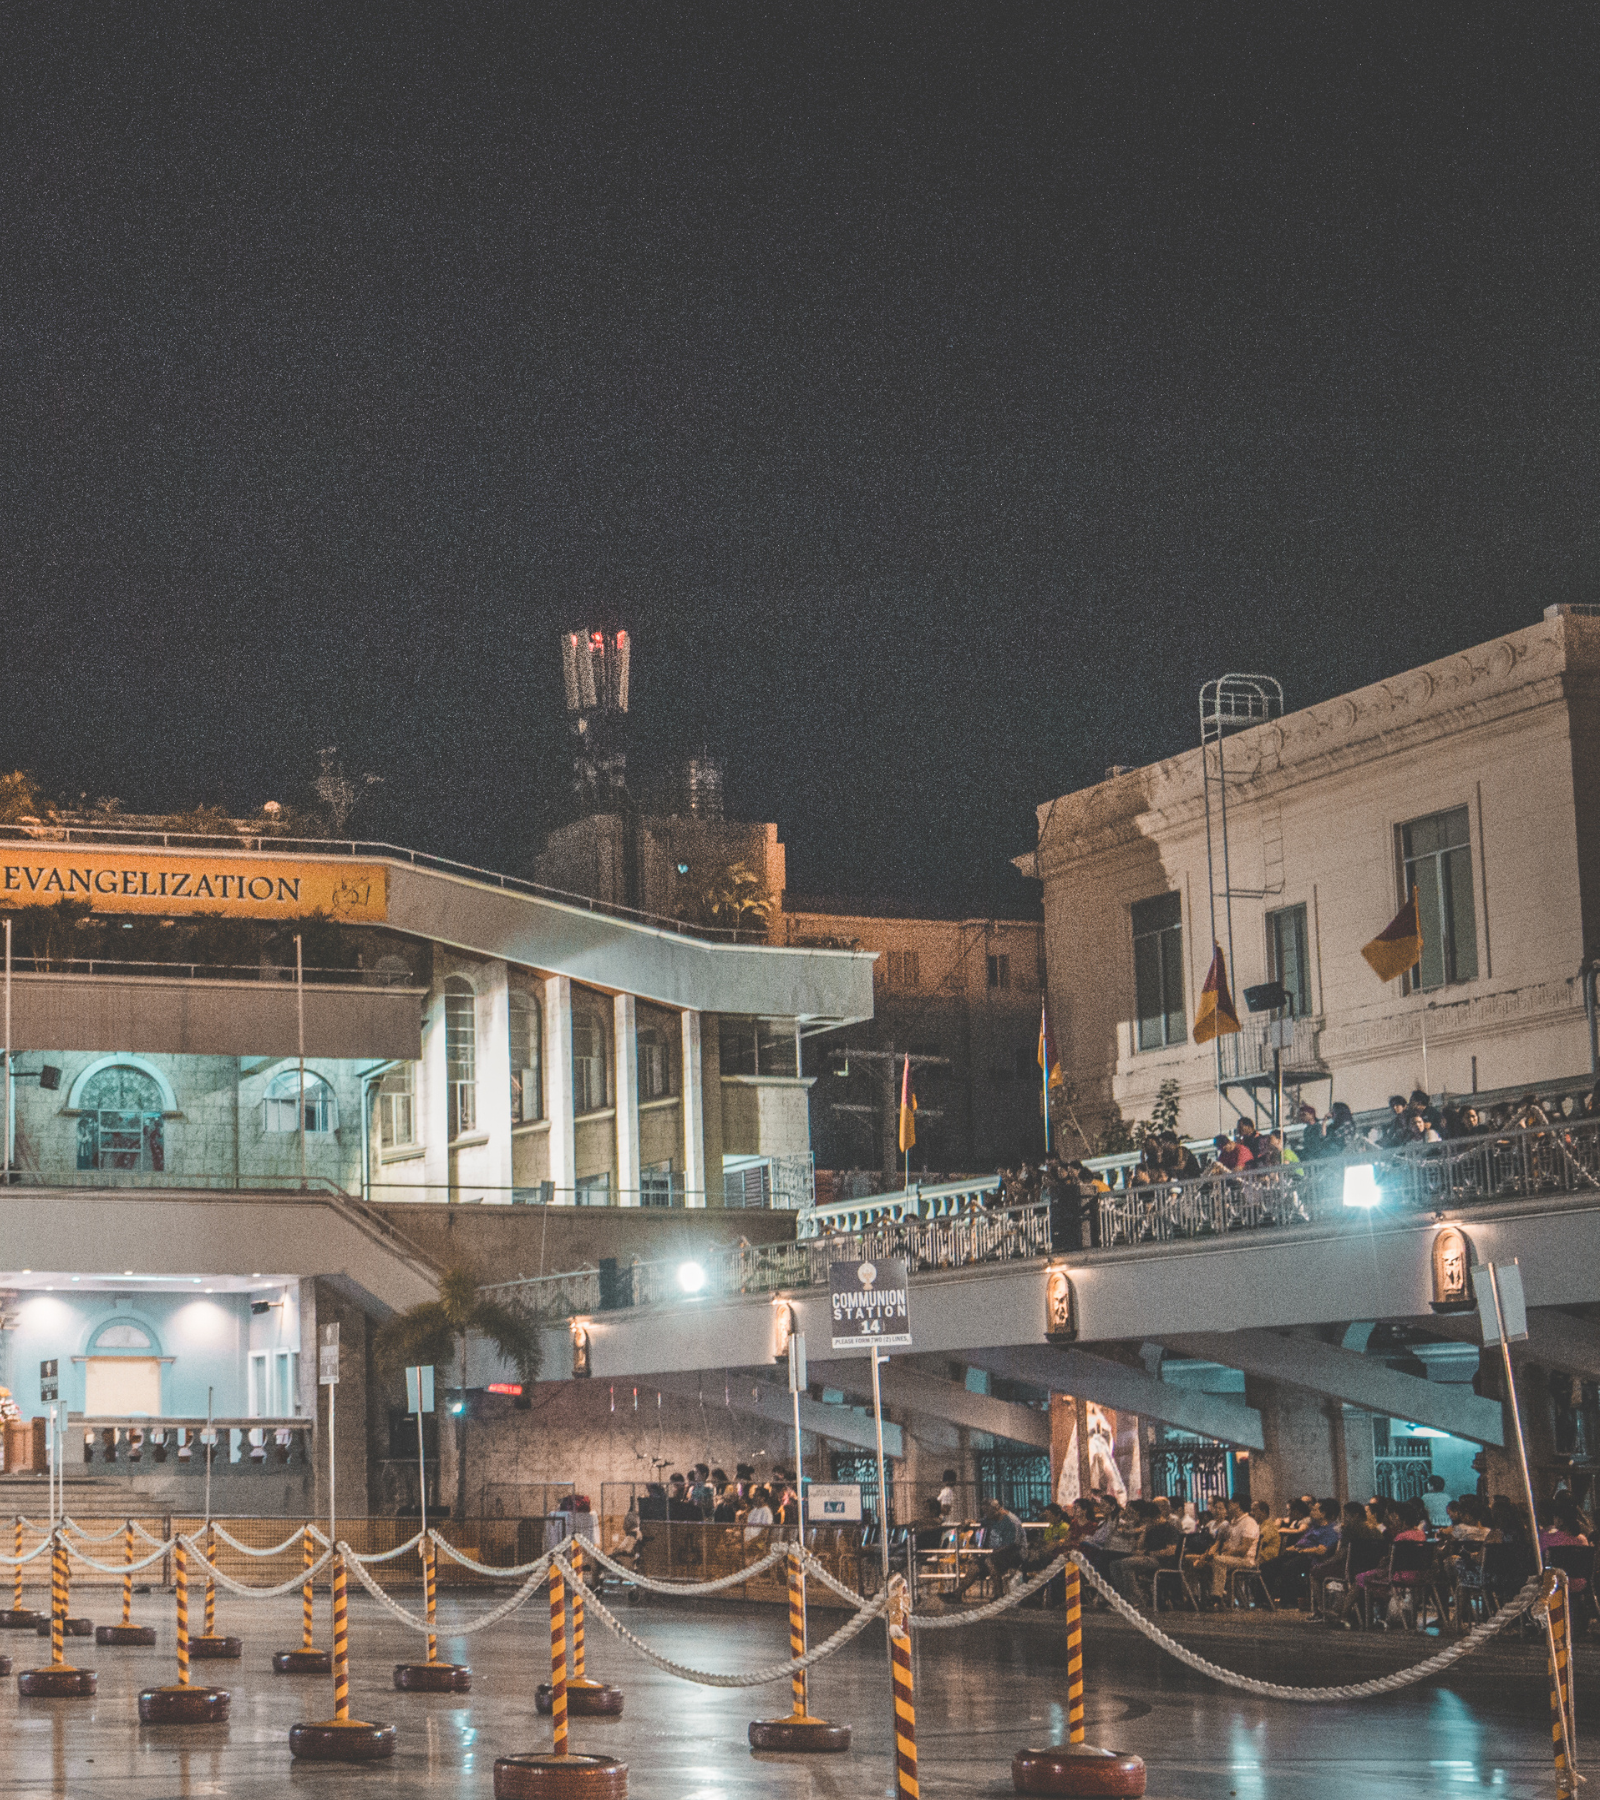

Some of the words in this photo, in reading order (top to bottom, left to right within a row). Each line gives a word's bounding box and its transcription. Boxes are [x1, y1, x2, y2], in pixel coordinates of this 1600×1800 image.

[4, 866, 301, 902] EVANGELIZATION
[832, 1290, 906, 1308] COMMUNION
[833, 1305, 906, 1320] STATION
[861, 1319, 881, 1334] 14
